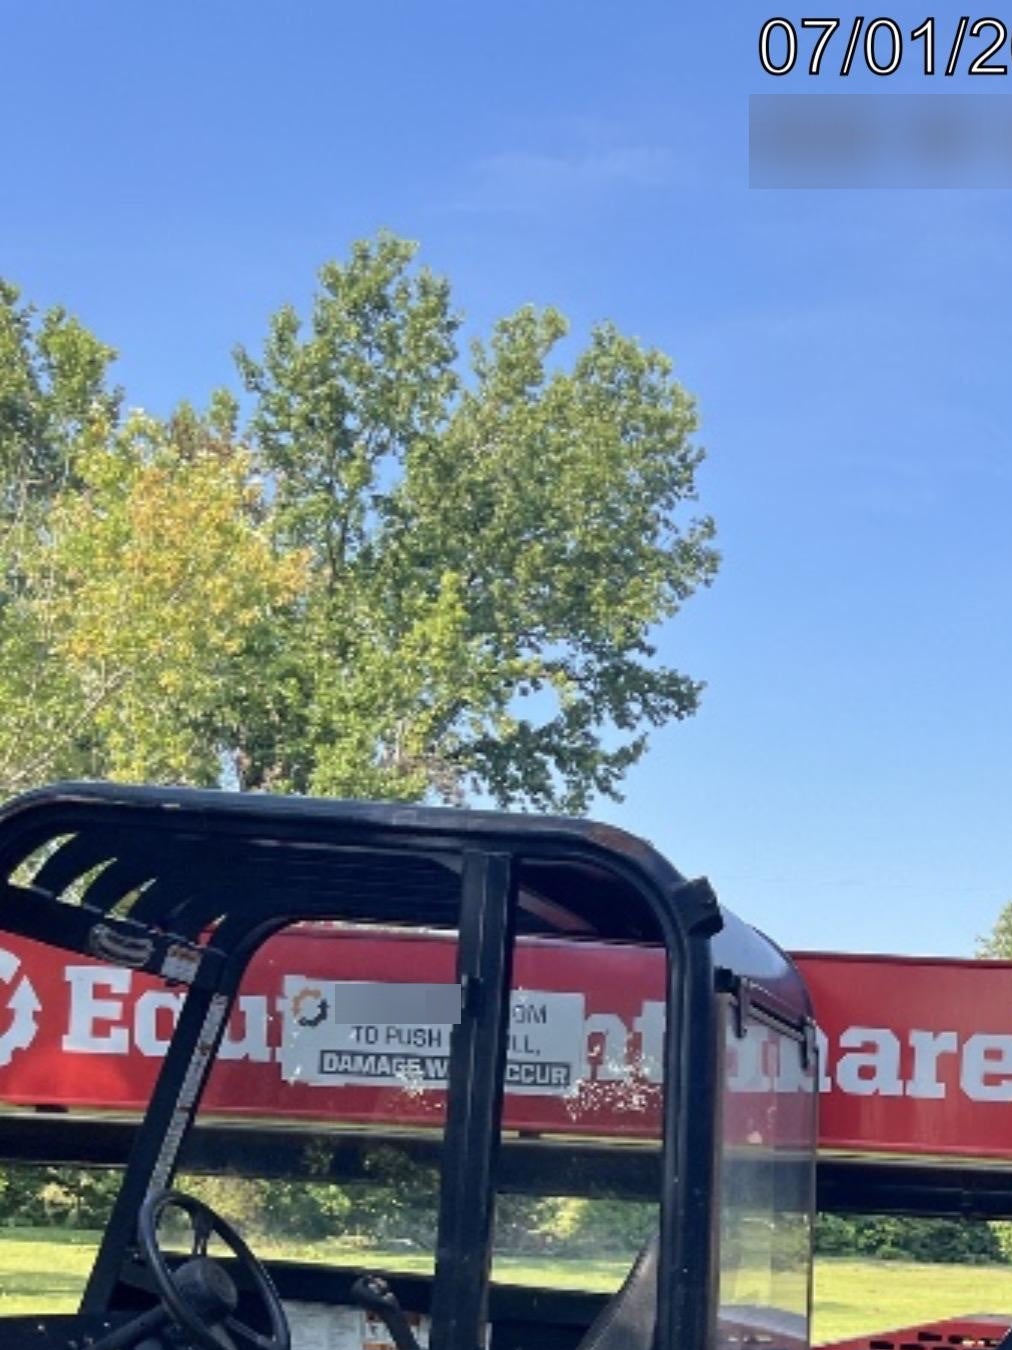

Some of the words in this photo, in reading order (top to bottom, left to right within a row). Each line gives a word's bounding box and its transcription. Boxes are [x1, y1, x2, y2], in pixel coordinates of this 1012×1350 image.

[353, 1025, 379, 1045] TO
[385, 1025, 441, 1048] PUSH
[506, 1064, 567, 1086] CCUR
